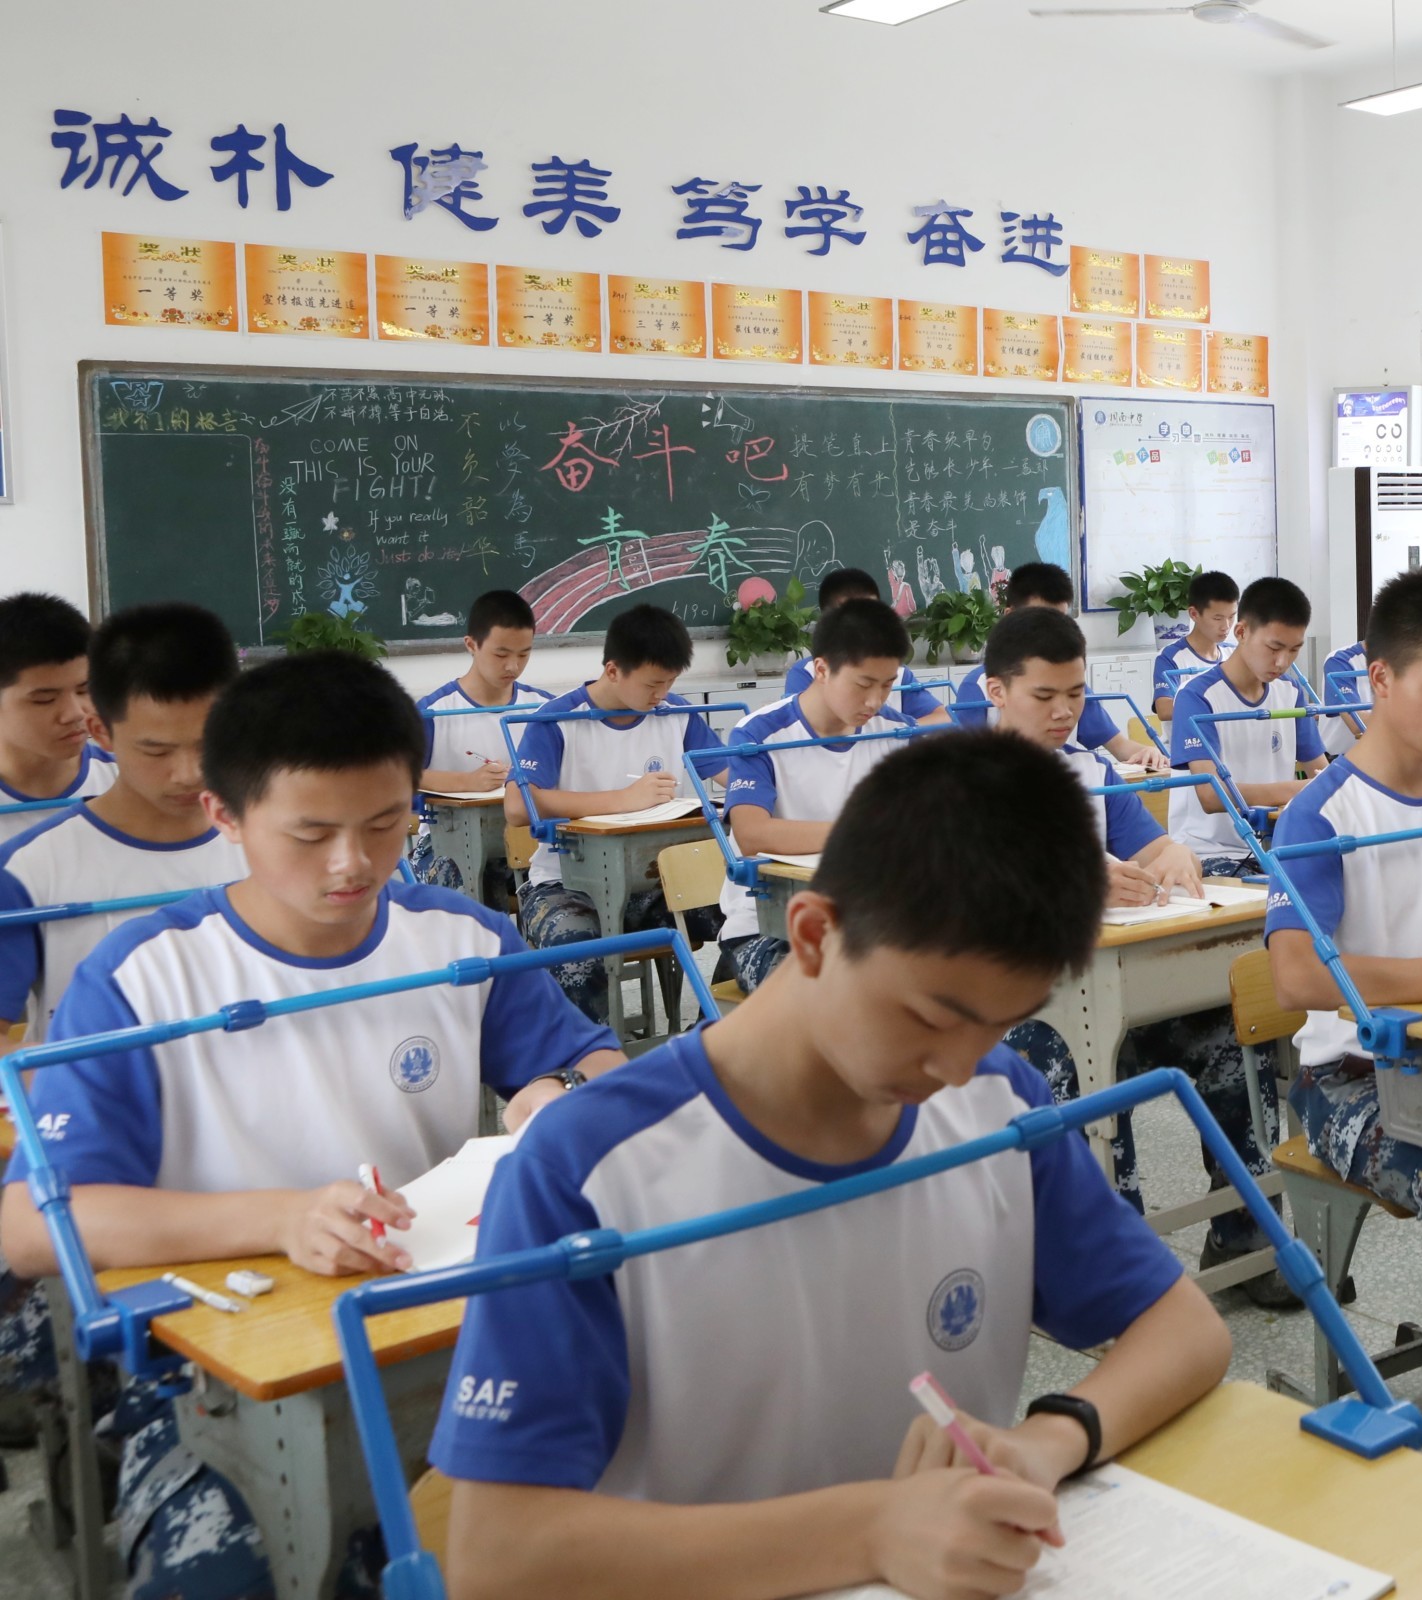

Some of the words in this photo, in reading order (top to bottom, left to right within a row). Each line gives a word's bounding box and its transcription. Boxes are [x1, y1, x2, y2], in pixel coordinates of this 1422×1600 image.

[51, 109, 334, 212] 诚朴
[389, 142, 620, 238] 健美
[672, 176, 867, 256] 笃学
[907, 199, 1070, 277] 奋进
[137, 287, 204, 302] 一等奖
[404, 304, 461, 319] 一等奖
[523, 313, 574, 326] 一等奖
[636, 319, 681, 331] 三等奖
[310, 437, 371, 454] COME
[394, 434, 419, 452] ON
[788, 431, 897, 458] 提笔直上
[289, 459, 339, 483] THIS
[358, 455, 378, 477] IS
[540, 421, 788, 501] 奋斗吧
[332, 474, 438, 503] FIGHT!
[788, 469, 895, 503] 有梦有光
[903, 489, 1027, 518] 青春最美的装饰
[368, 509, 380, 533] If
[384, 514, 403, 531] you
[409, 506, 448, 528] really
[904, 517, 958, 543] 是奋斗
[375, 531, 410, 546] want
[418, 529, 430, 543] it
[577, 506, 760, 595] 青春
[375, 549, 411, 564] Just
[418, 545, 434, 563] do
